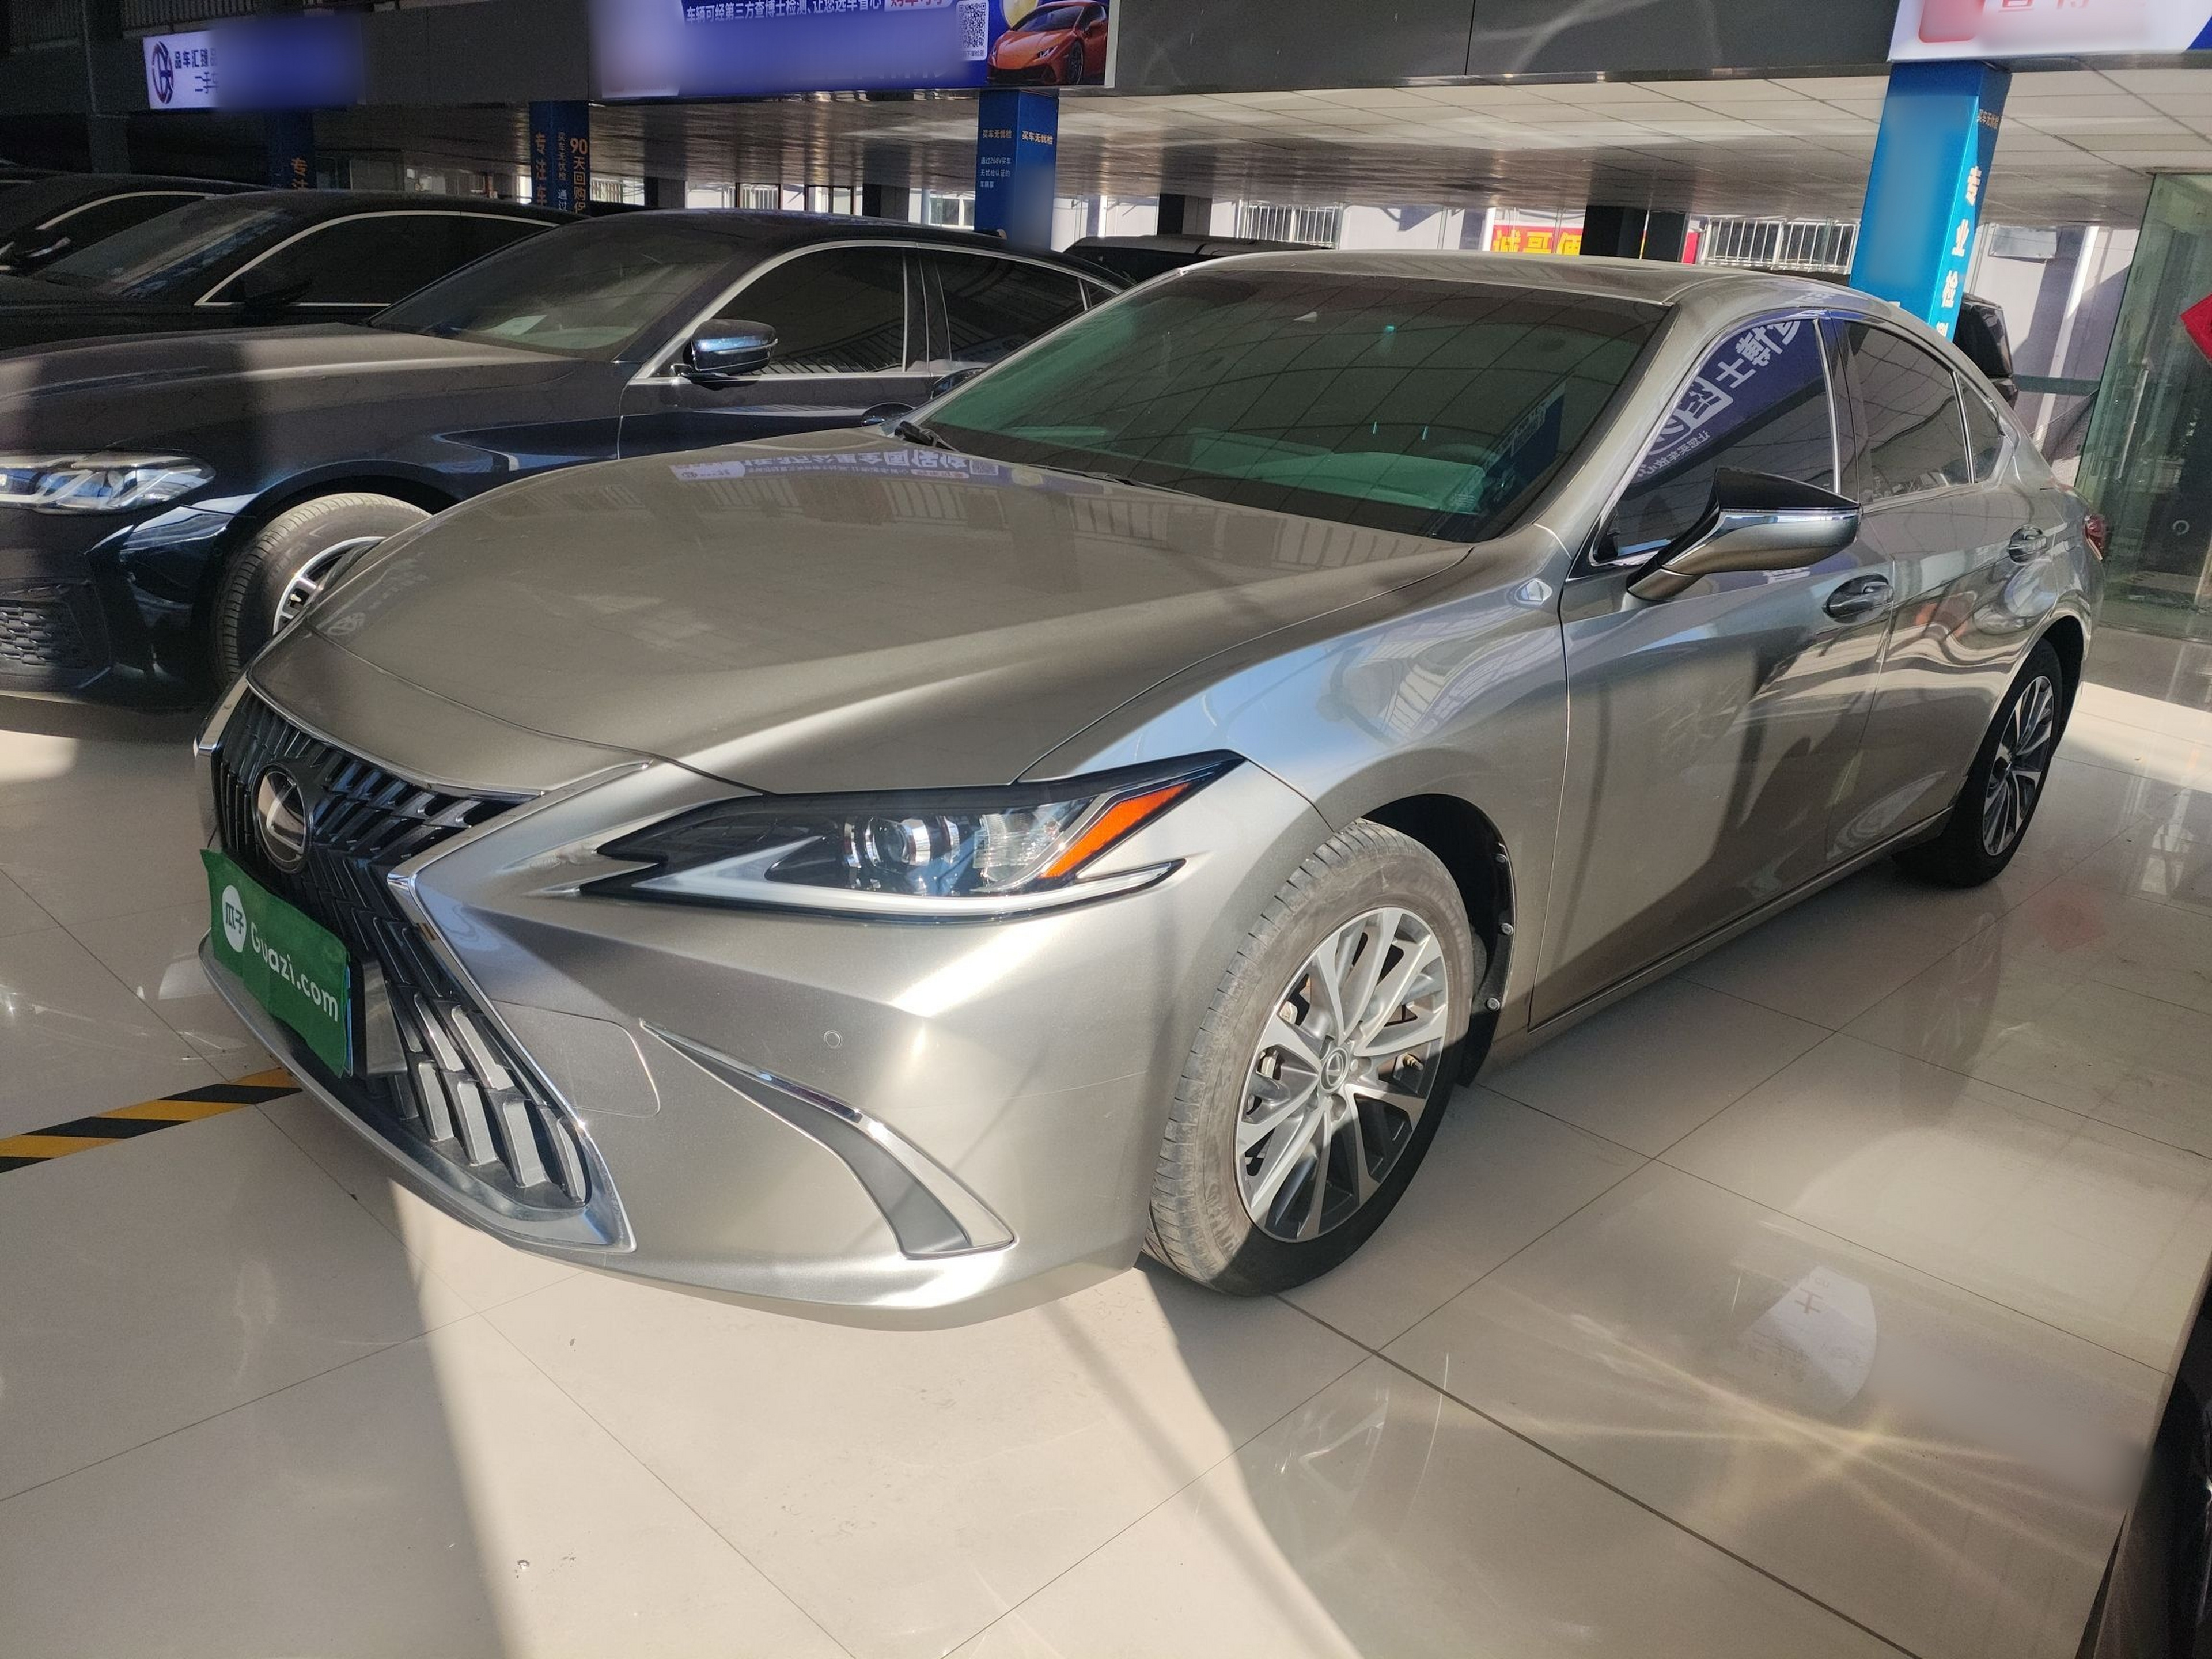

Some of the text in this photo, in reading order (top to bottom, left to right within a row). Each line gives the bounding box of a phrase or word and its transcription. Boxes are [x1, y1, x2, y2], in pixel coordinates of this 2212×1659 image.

[983, 129, 1013, 139] 买车无忧检
[1022, 130, 1054, 145] 买车无忧检
[225, 902, 244, 934] 瓜子
[251, 921, 339, 1022] Guazi.com
